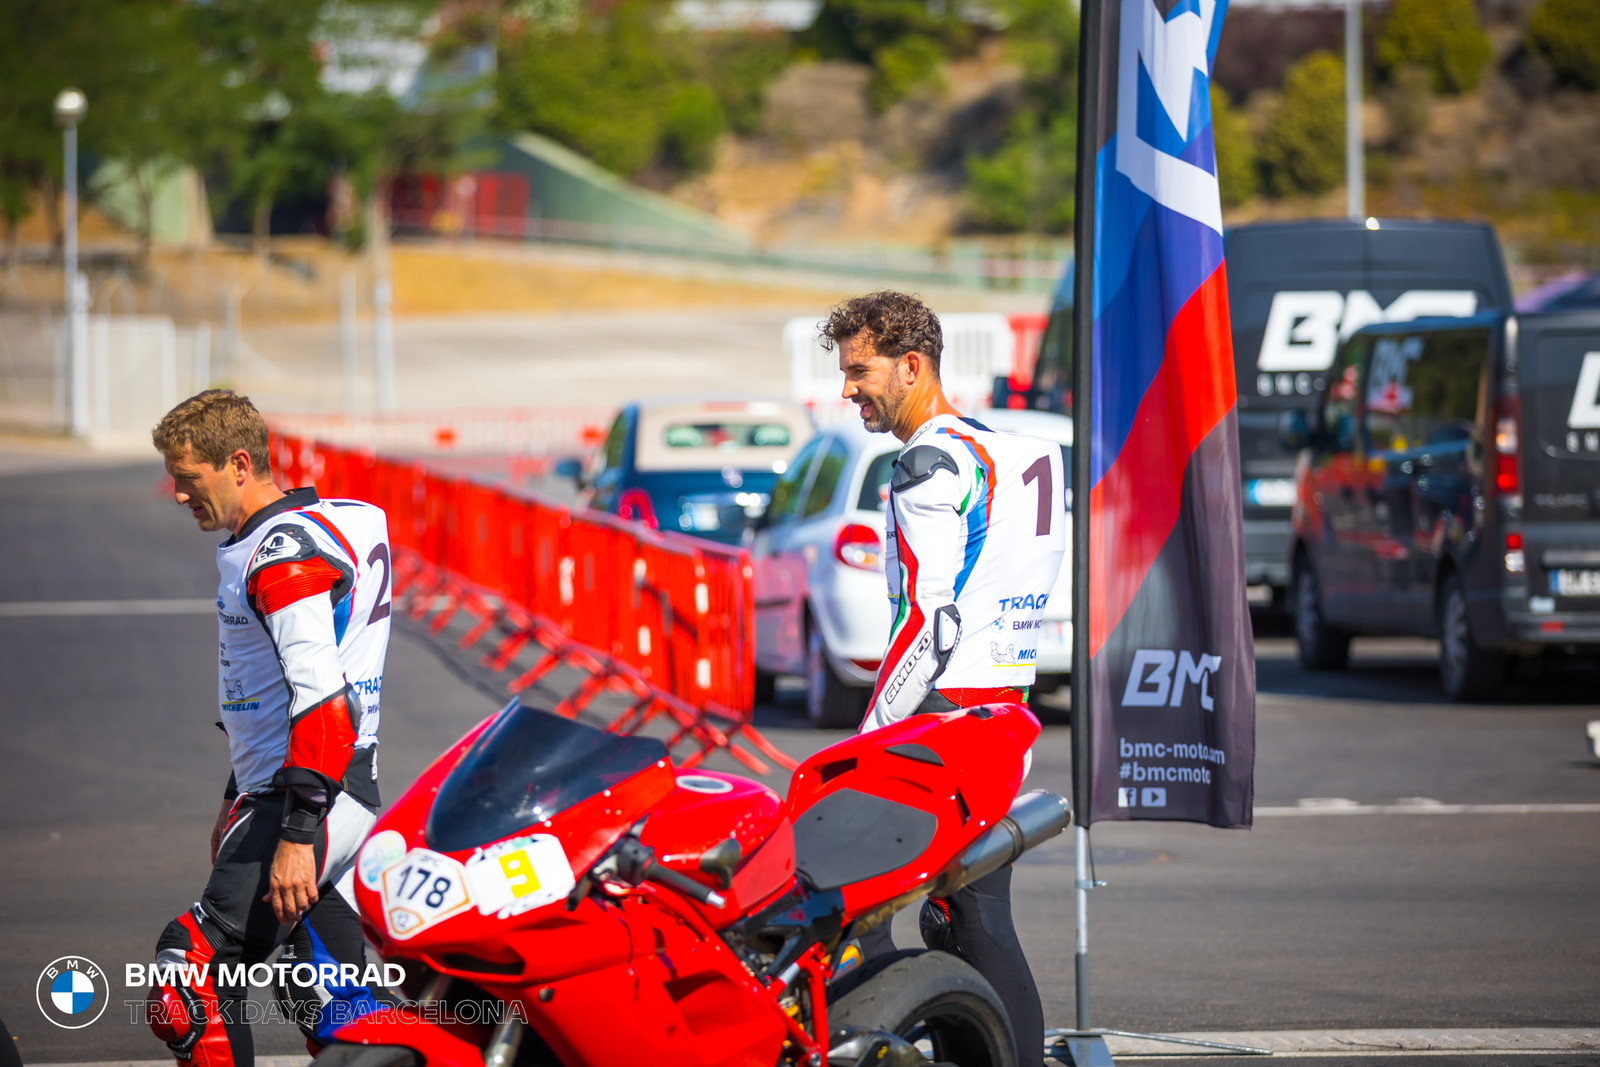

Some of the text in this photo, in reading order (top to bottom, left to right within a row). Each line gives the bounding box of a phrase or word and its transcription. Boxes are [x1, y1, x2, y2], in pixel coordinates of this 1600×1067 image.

[1022, 455, 1052, 537] 1
[367, 543, 390, 626] 2
[1012, 620, 1034, 630] BMW
[885, 631, 933, 705] GIMOTO
[397, 865, 451, 909] 178
[499, 849, 540, 899] 9
